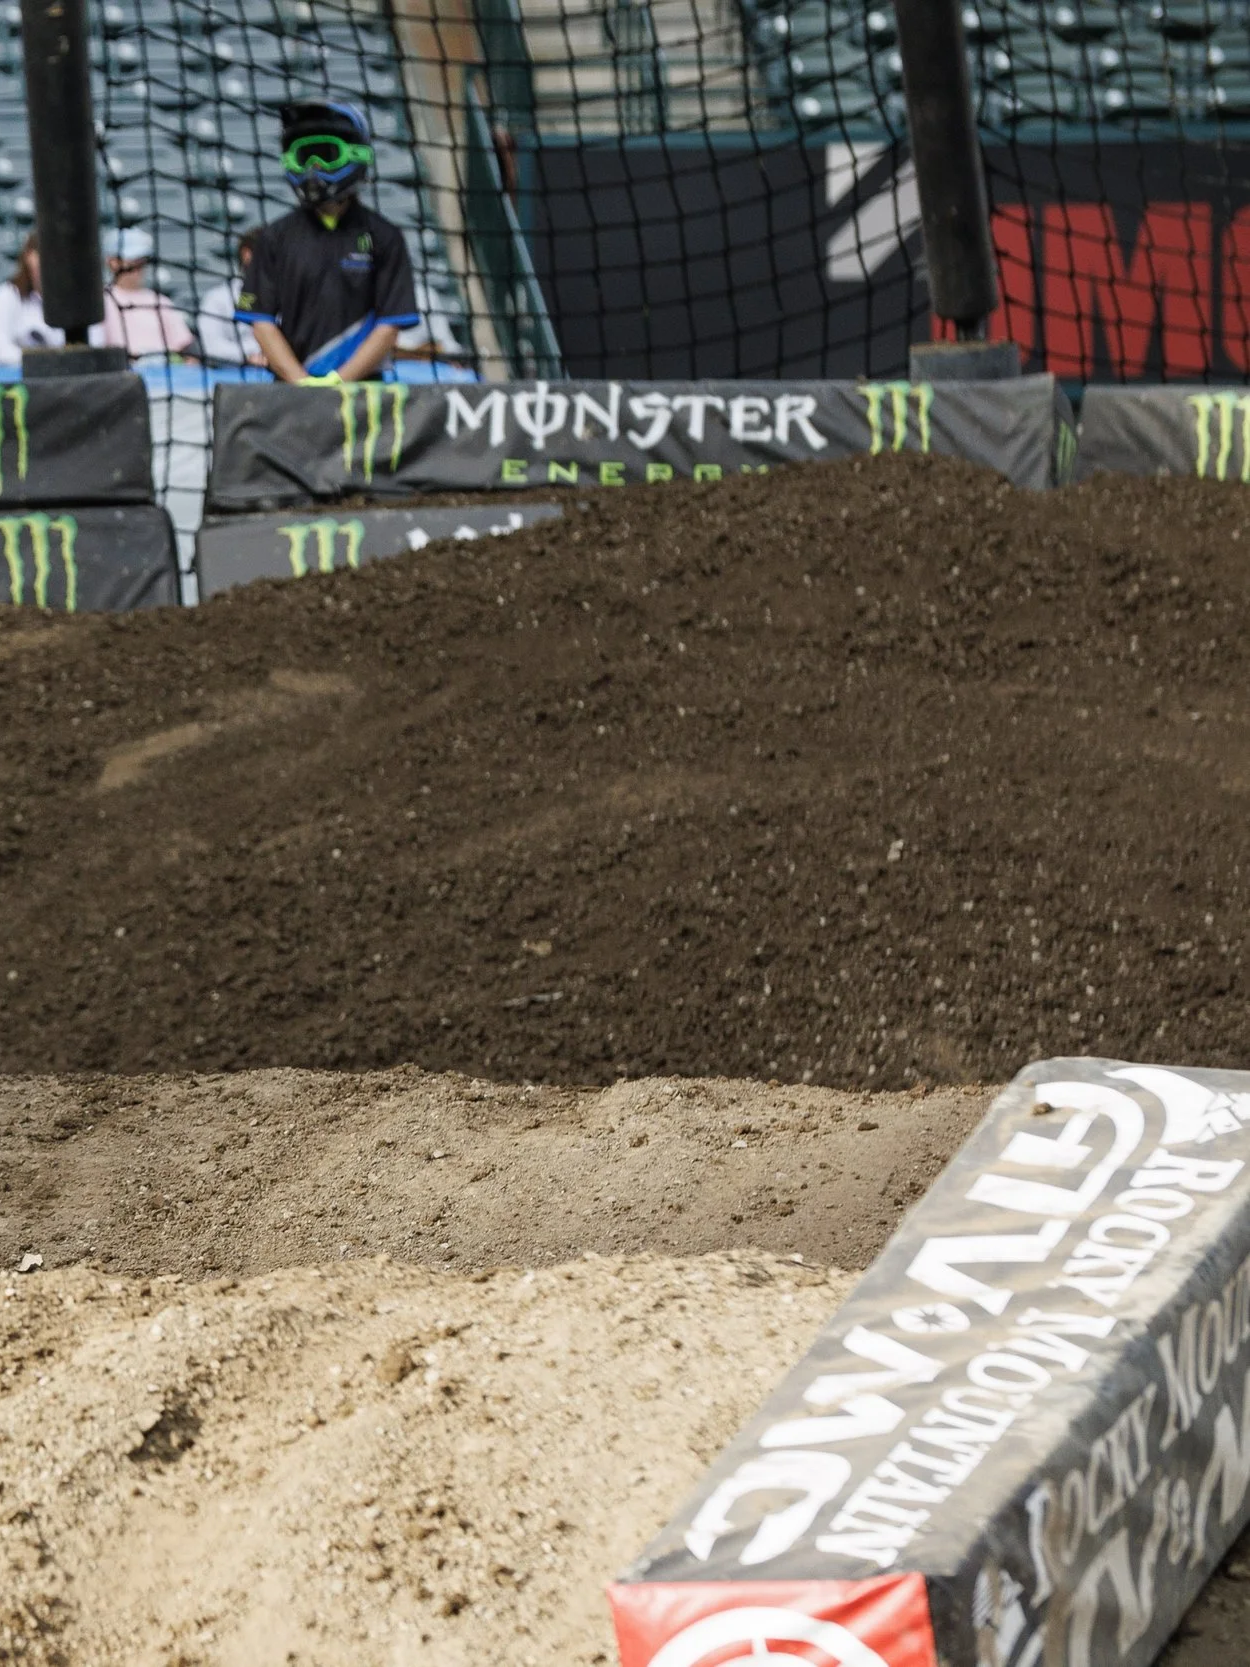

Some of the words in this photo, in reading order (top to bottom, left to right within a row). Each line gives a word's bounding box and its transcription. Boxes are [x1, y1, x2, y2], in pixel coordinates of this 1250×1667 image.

[445, 380, 829, 451] MONSTER
[905, 1081, 1145, 1317] ATV
[1045, 1147, 1246, 1308] ROCKY
[815, 1307, 1119, 1569] MOUNTAIN
